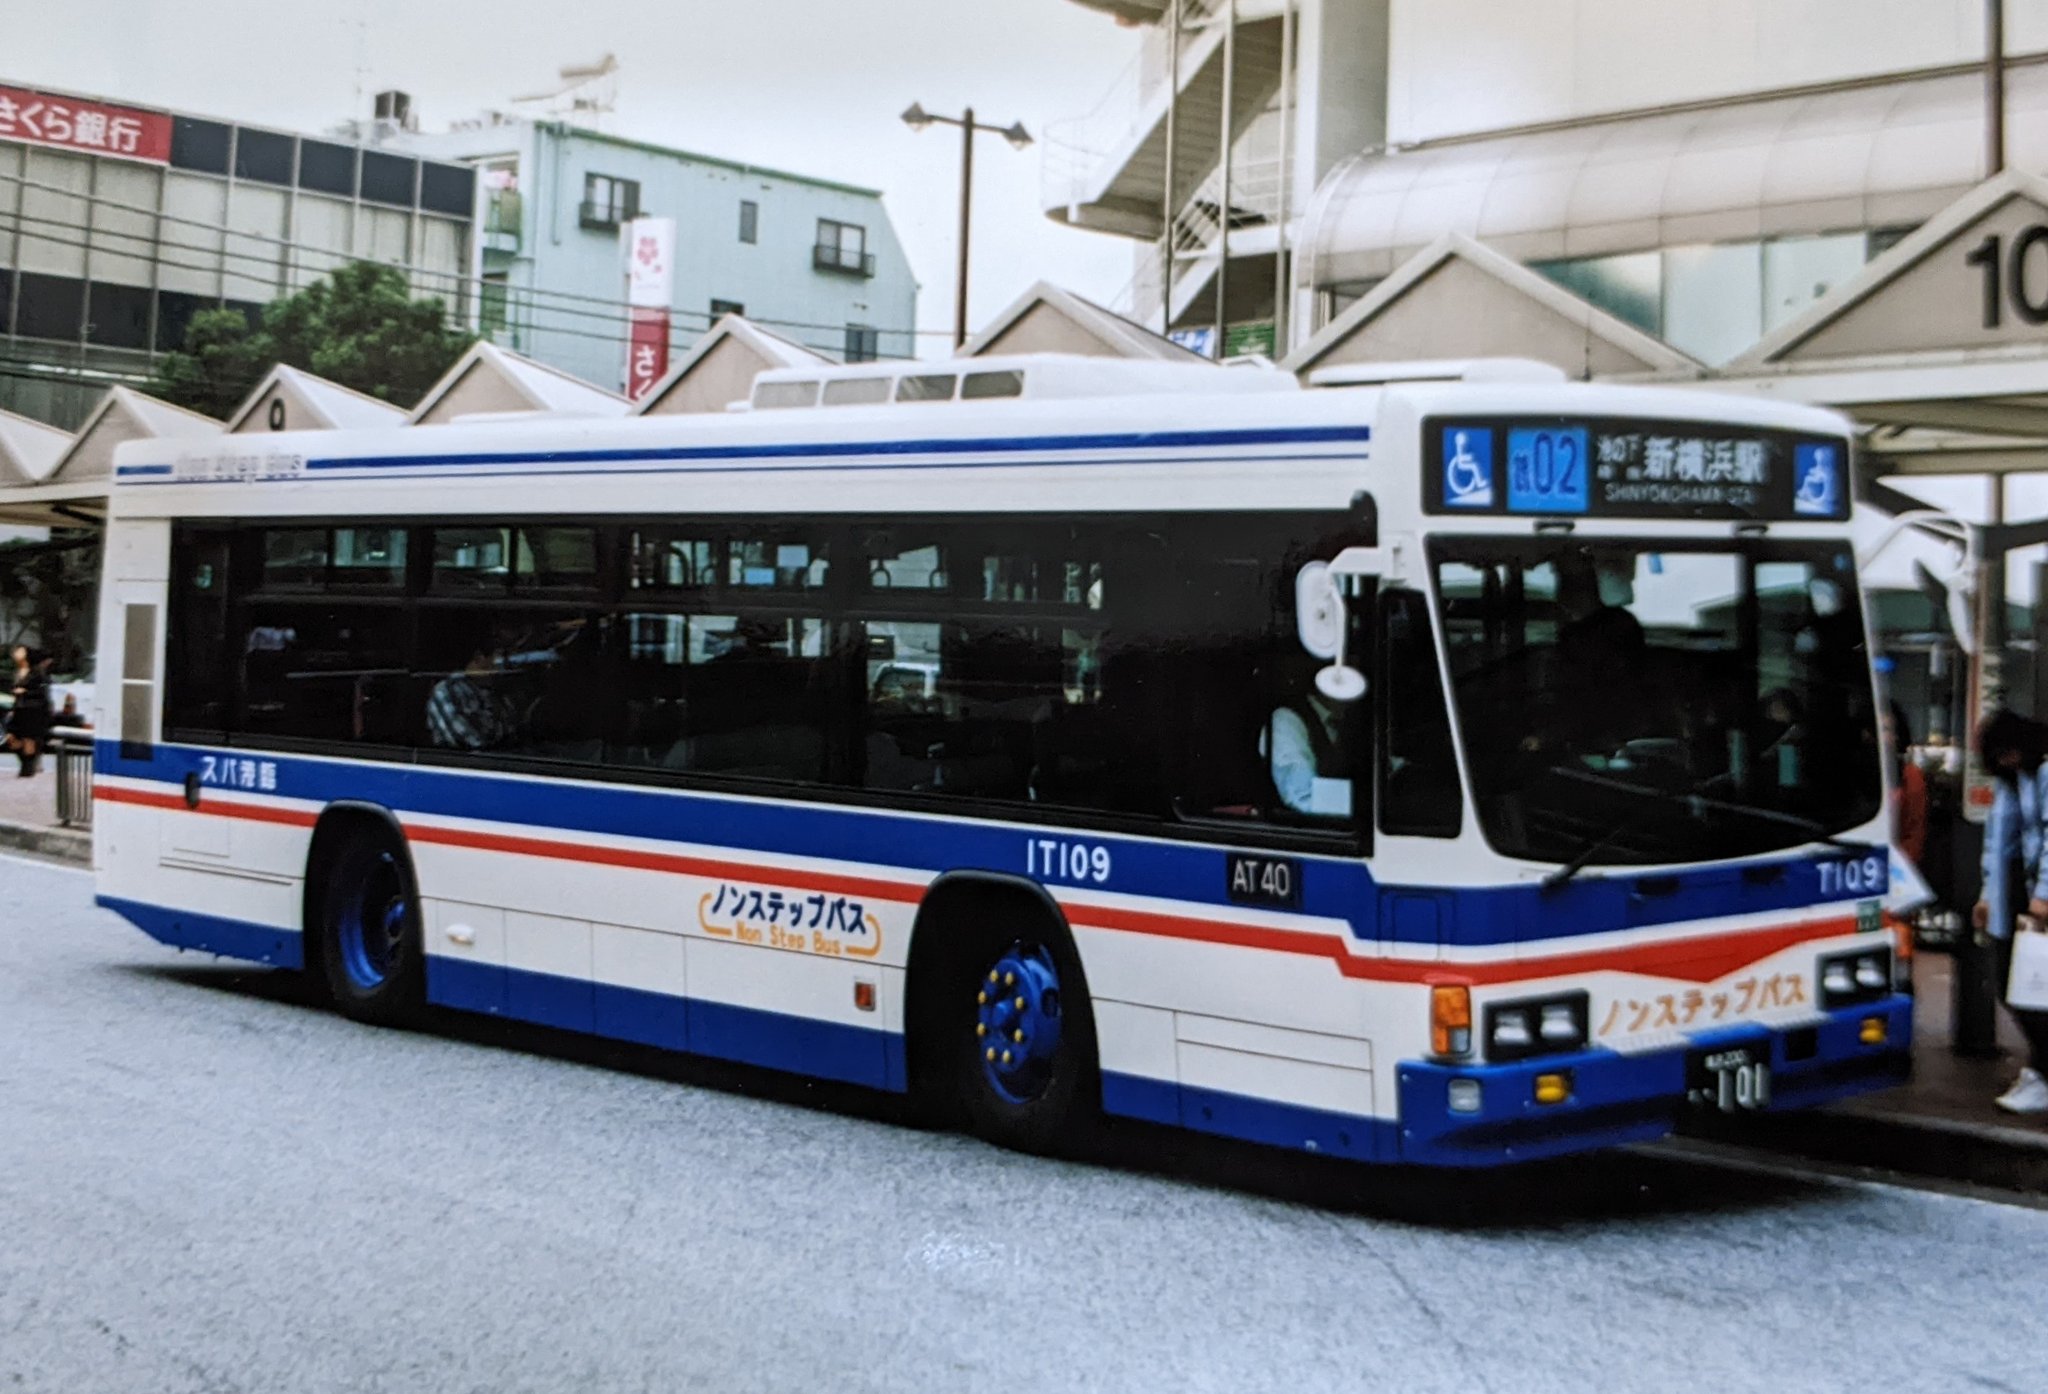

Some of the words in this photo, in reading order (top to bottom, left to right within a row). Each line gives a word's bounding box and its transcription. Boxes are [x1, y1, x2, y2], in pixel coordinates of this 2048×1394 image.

[0, 95, 142, 152] さくら銀行
[1965, 225, 2048, 330] 10
[1232, 858, 1258, 893] AT
[1260, 862, 1290, 897] 40
[712, 884, 867, 935] ノンステップバス
[769, 924, 805, 949] Step
[812, 930, 841, 955] Bus
[1598, 974, 1805, 1036] ノンステップバス
